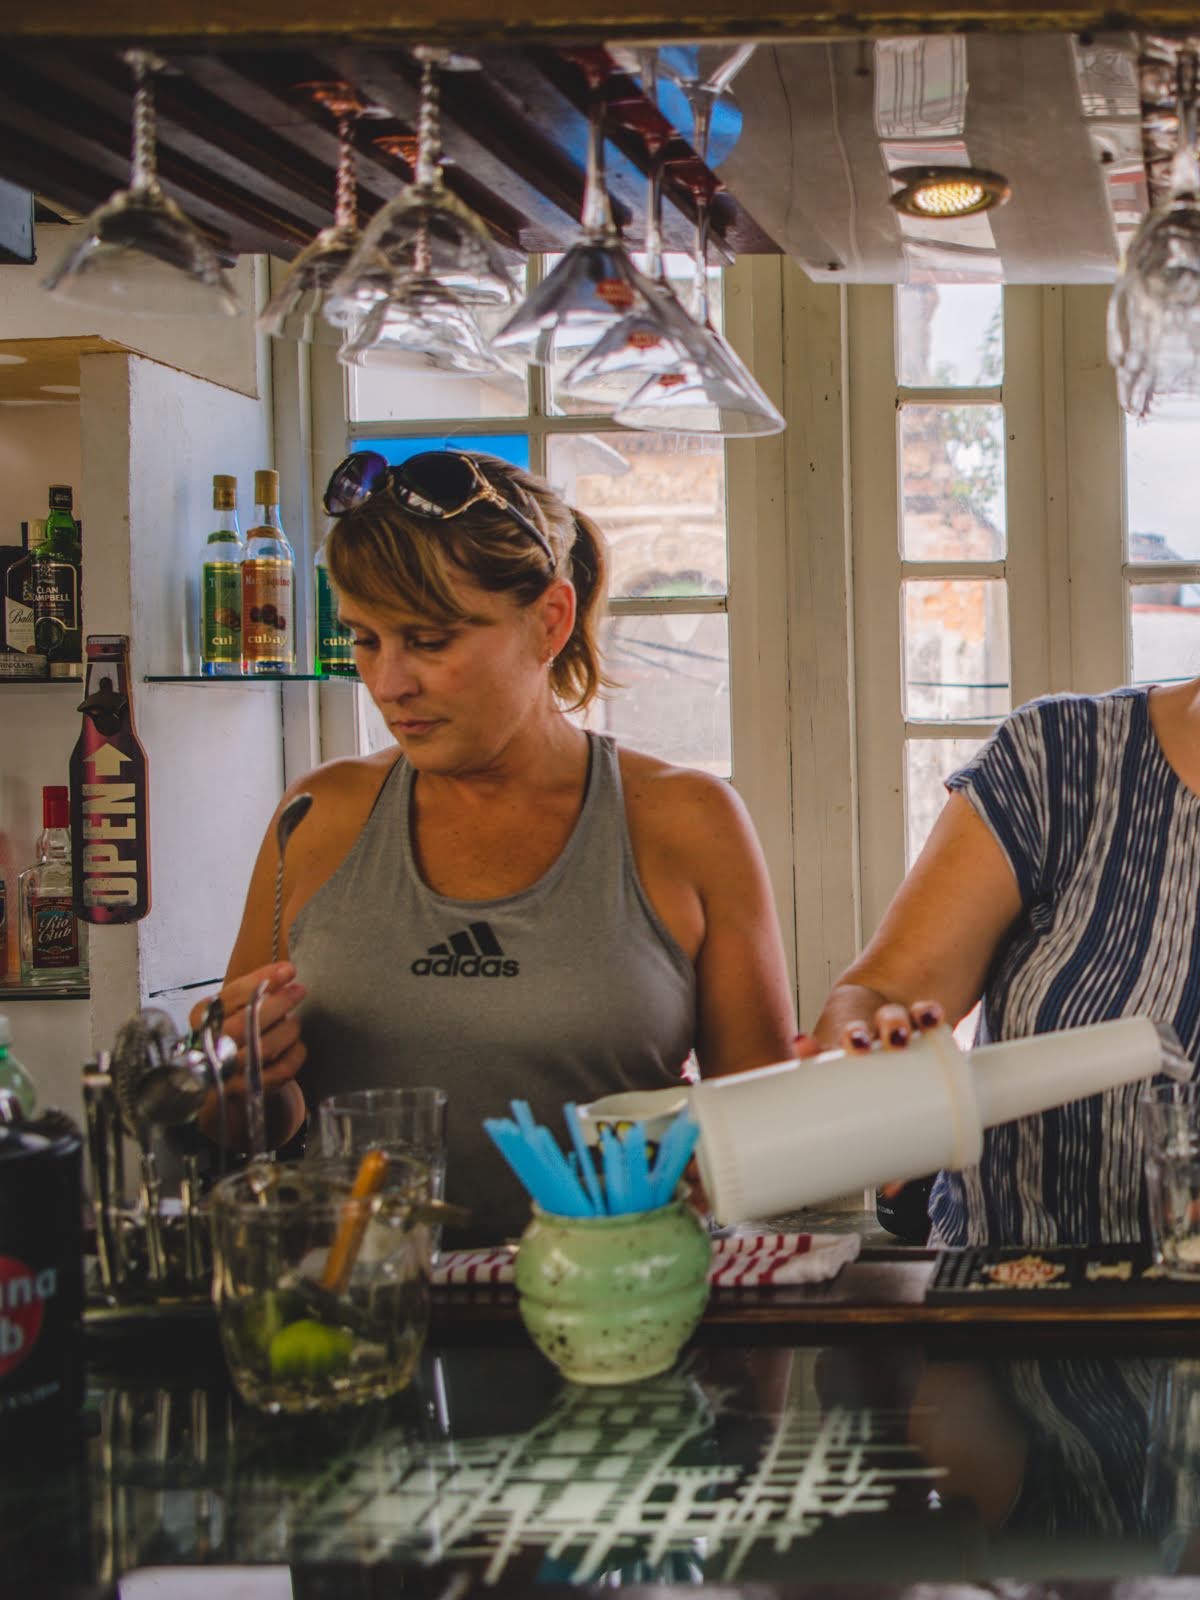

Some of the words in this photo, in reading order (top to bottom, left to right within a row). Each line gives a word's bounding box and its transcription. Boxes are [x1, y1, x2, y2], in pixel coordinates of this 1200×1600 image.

[36, 585, 59, 594] CLAN
[248, 633, 288, 646] cubay
[82, 783, 137, 907] OPEN
[40, 914, 69, 929] Rio
[38, 924, 72, 944] Club
[411, 954, 520, 977] adidas
